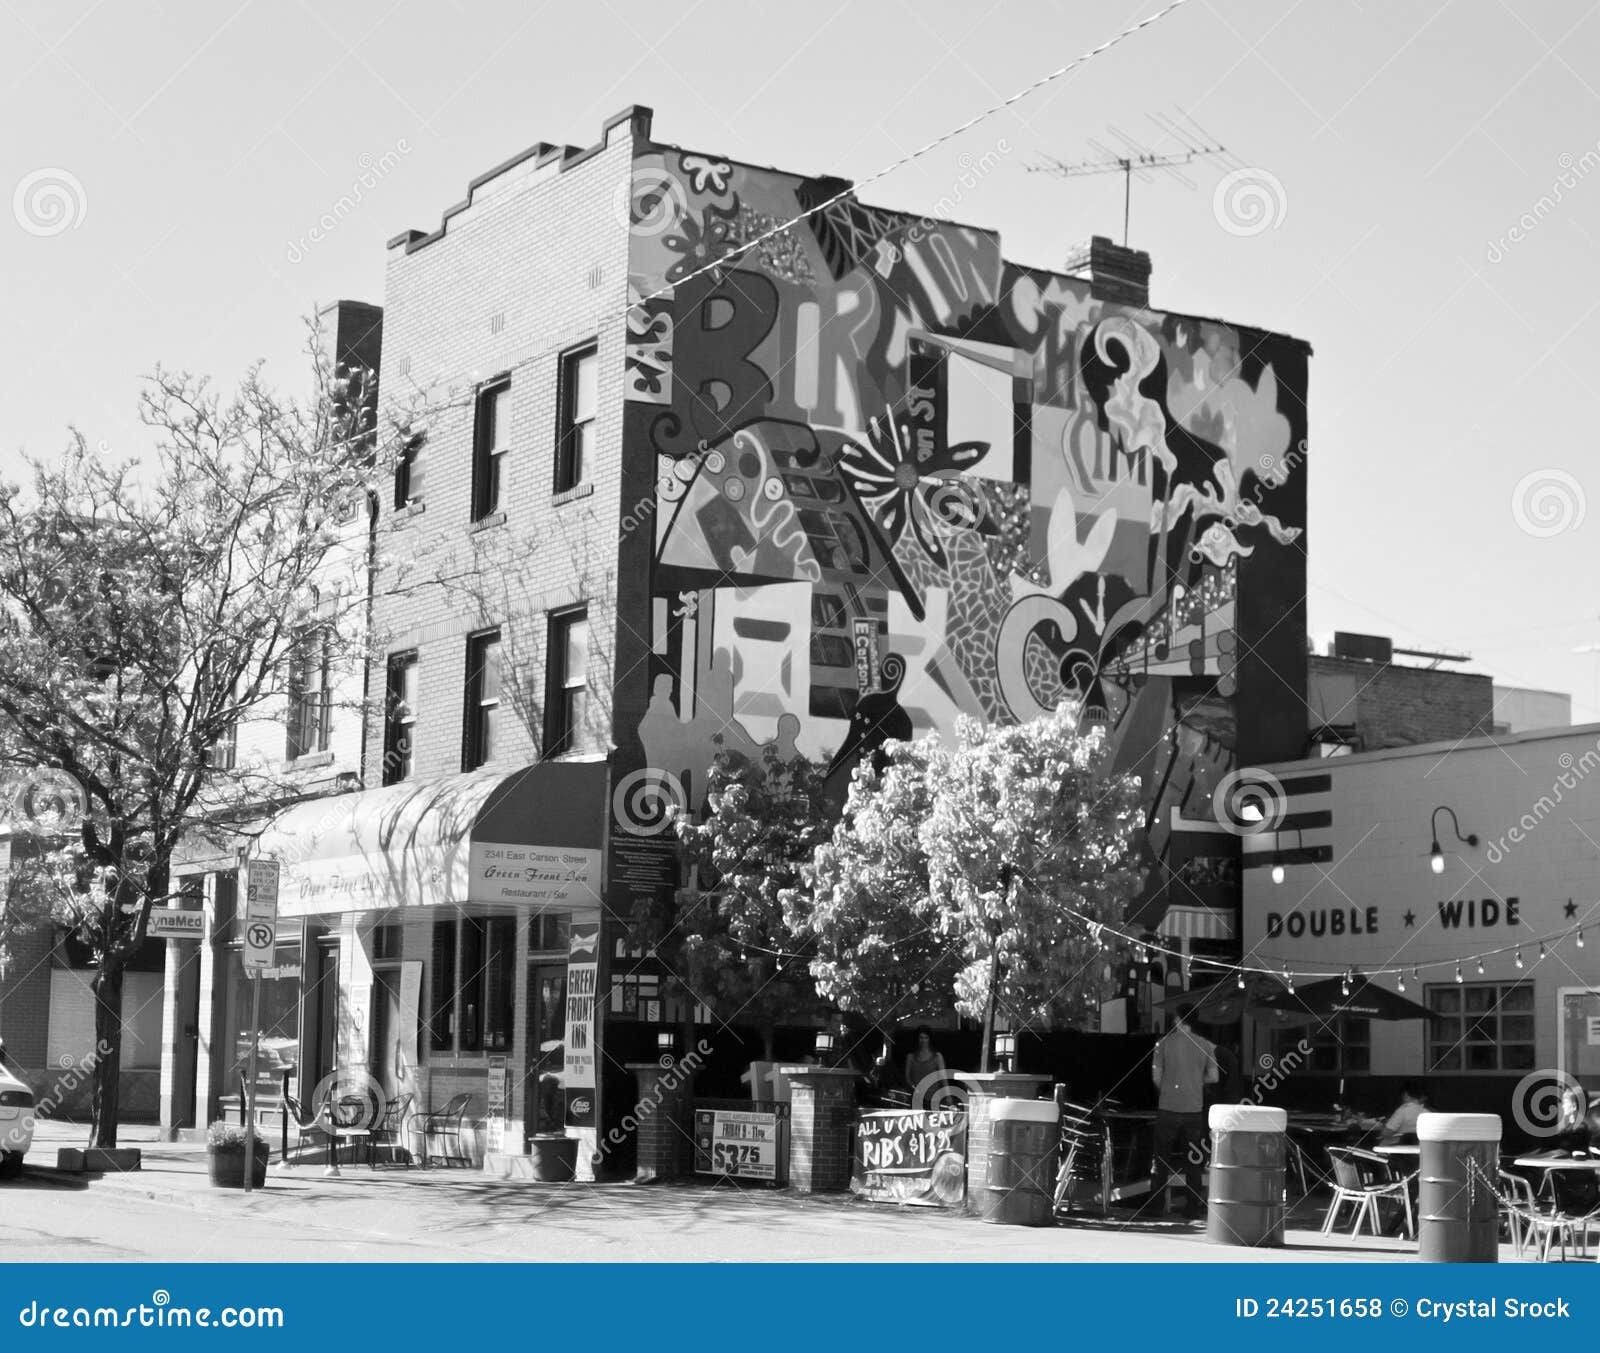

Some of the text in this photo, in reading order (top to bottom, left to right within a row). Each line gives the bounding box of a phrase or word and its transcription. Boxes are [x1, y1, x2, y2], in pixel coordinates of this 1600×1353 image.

[856, 635, 870, 686] Carson
[485, 849, 587, 864] 2341 East Carson Street
[484, 865, 588, 882] Green Front Inn
[501, 887, 547, 899] Restaurant
[147, 915, 202, 934] ynaMed
[1266, 896, 1521, 938] DOUBLE WIDE
[568, 969, 595, 995] GREEN
[567, 996, 594, 1022] FRONT
[571, 1023, 587, 1049] INN
[858, 1110, 954, 1137] ALL U CAN EAT
[863, 1135, 904, 1168] RIBS
